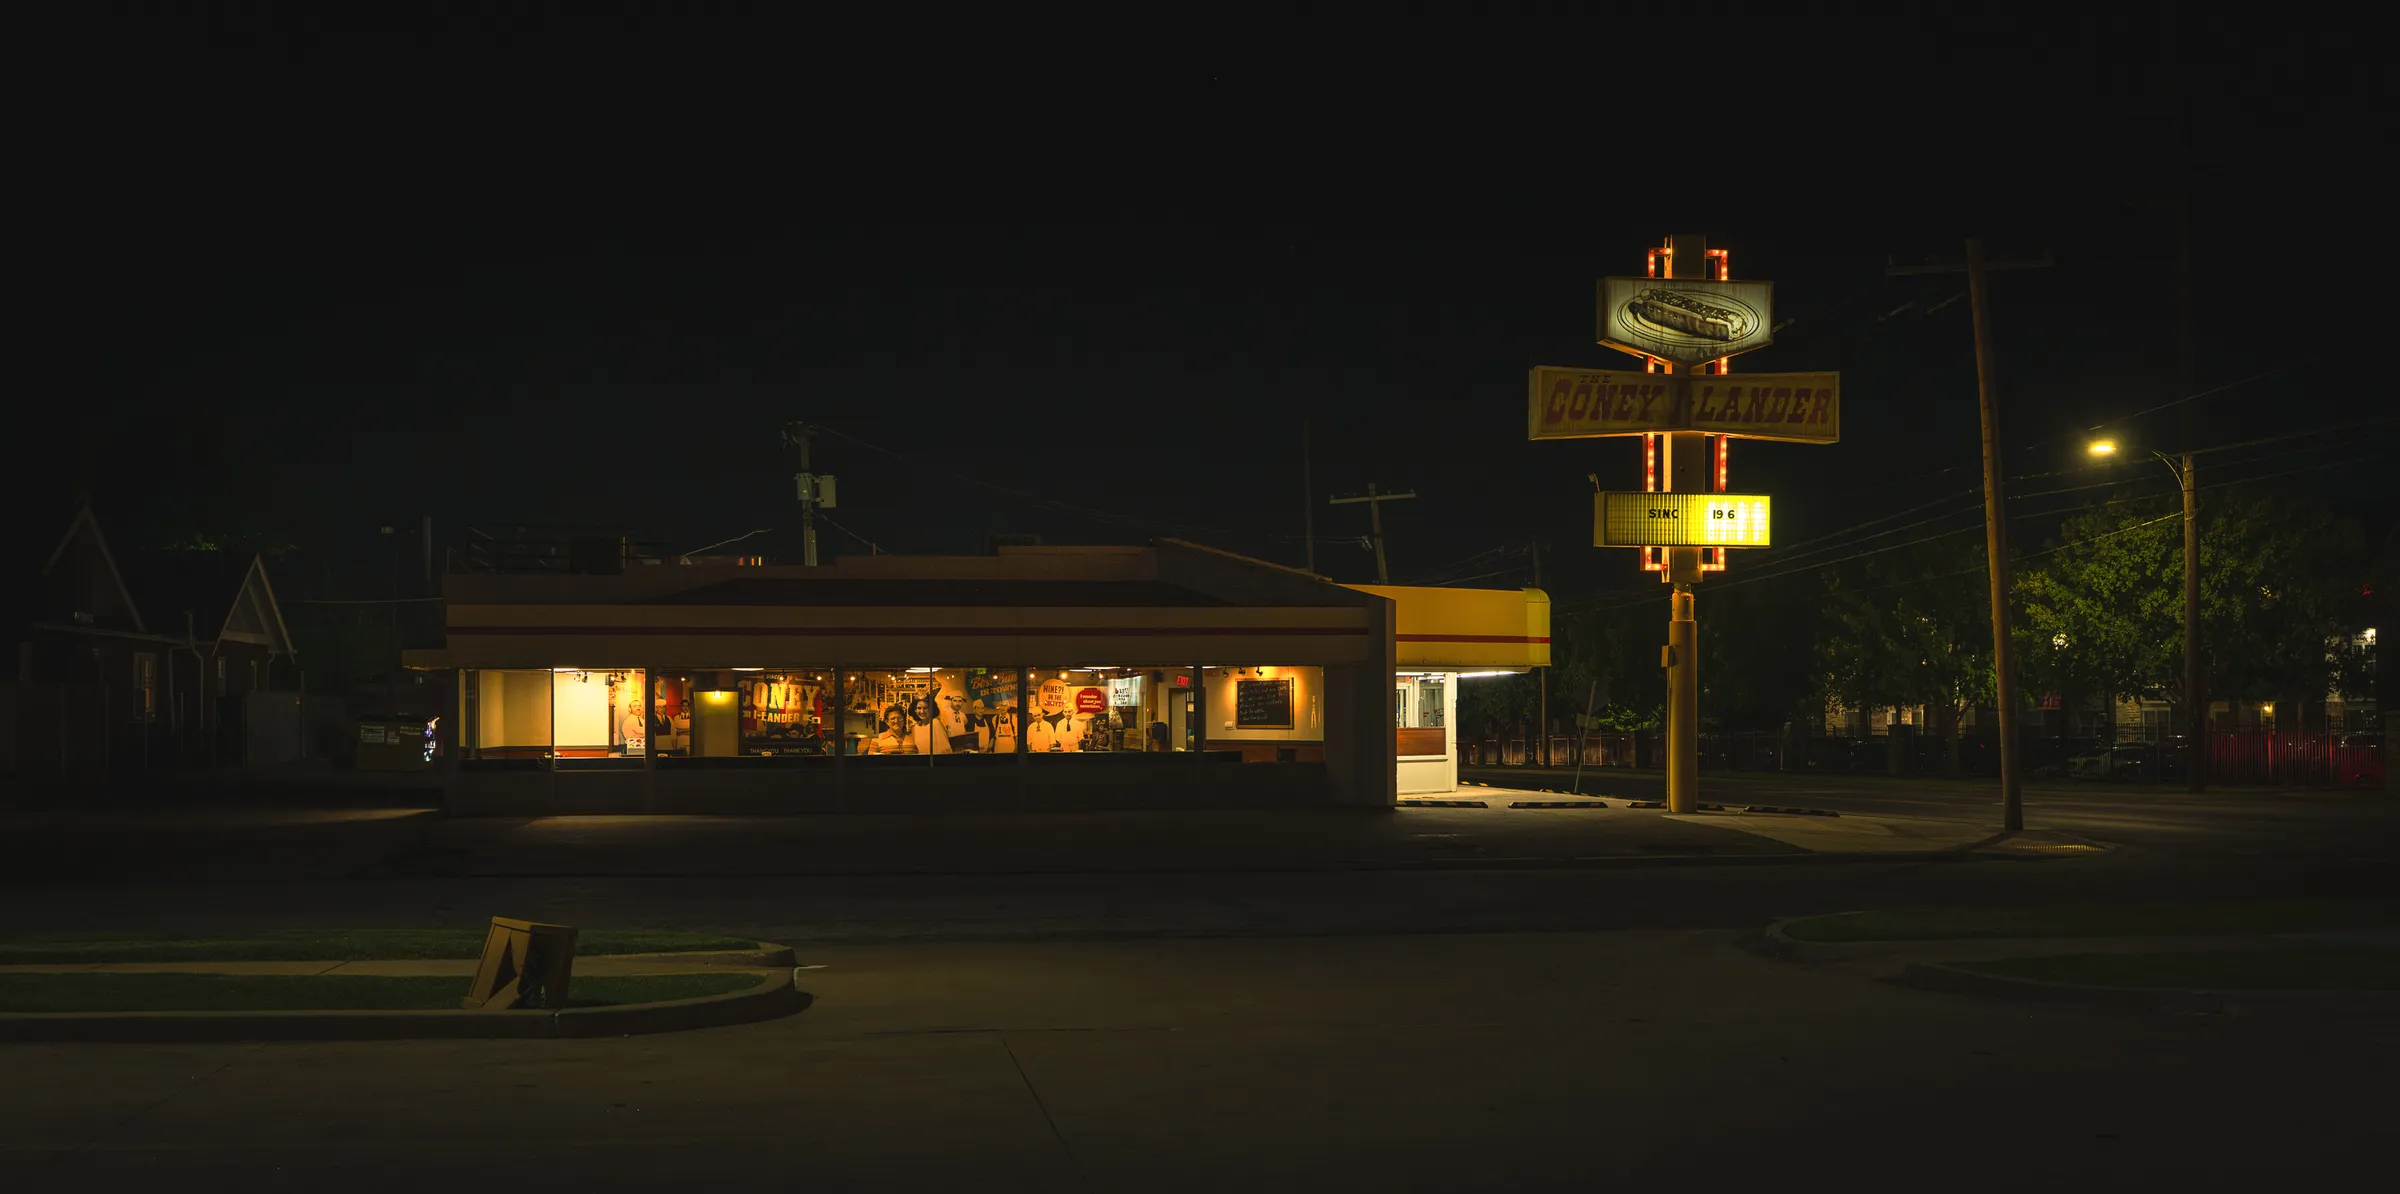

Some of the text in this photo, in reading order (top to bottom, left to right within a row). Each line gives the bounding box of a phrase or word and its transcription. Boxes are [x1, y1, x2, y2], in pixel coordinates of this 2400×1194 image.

[1579, 374, 1612, 384] THE
[1546, 378, 1665, 425] CONEY
[1649, 509, 1678, 519] SINC
[1176, 675, 1189, 687] EXIT
[738, 680, 822, 711] CONEY
